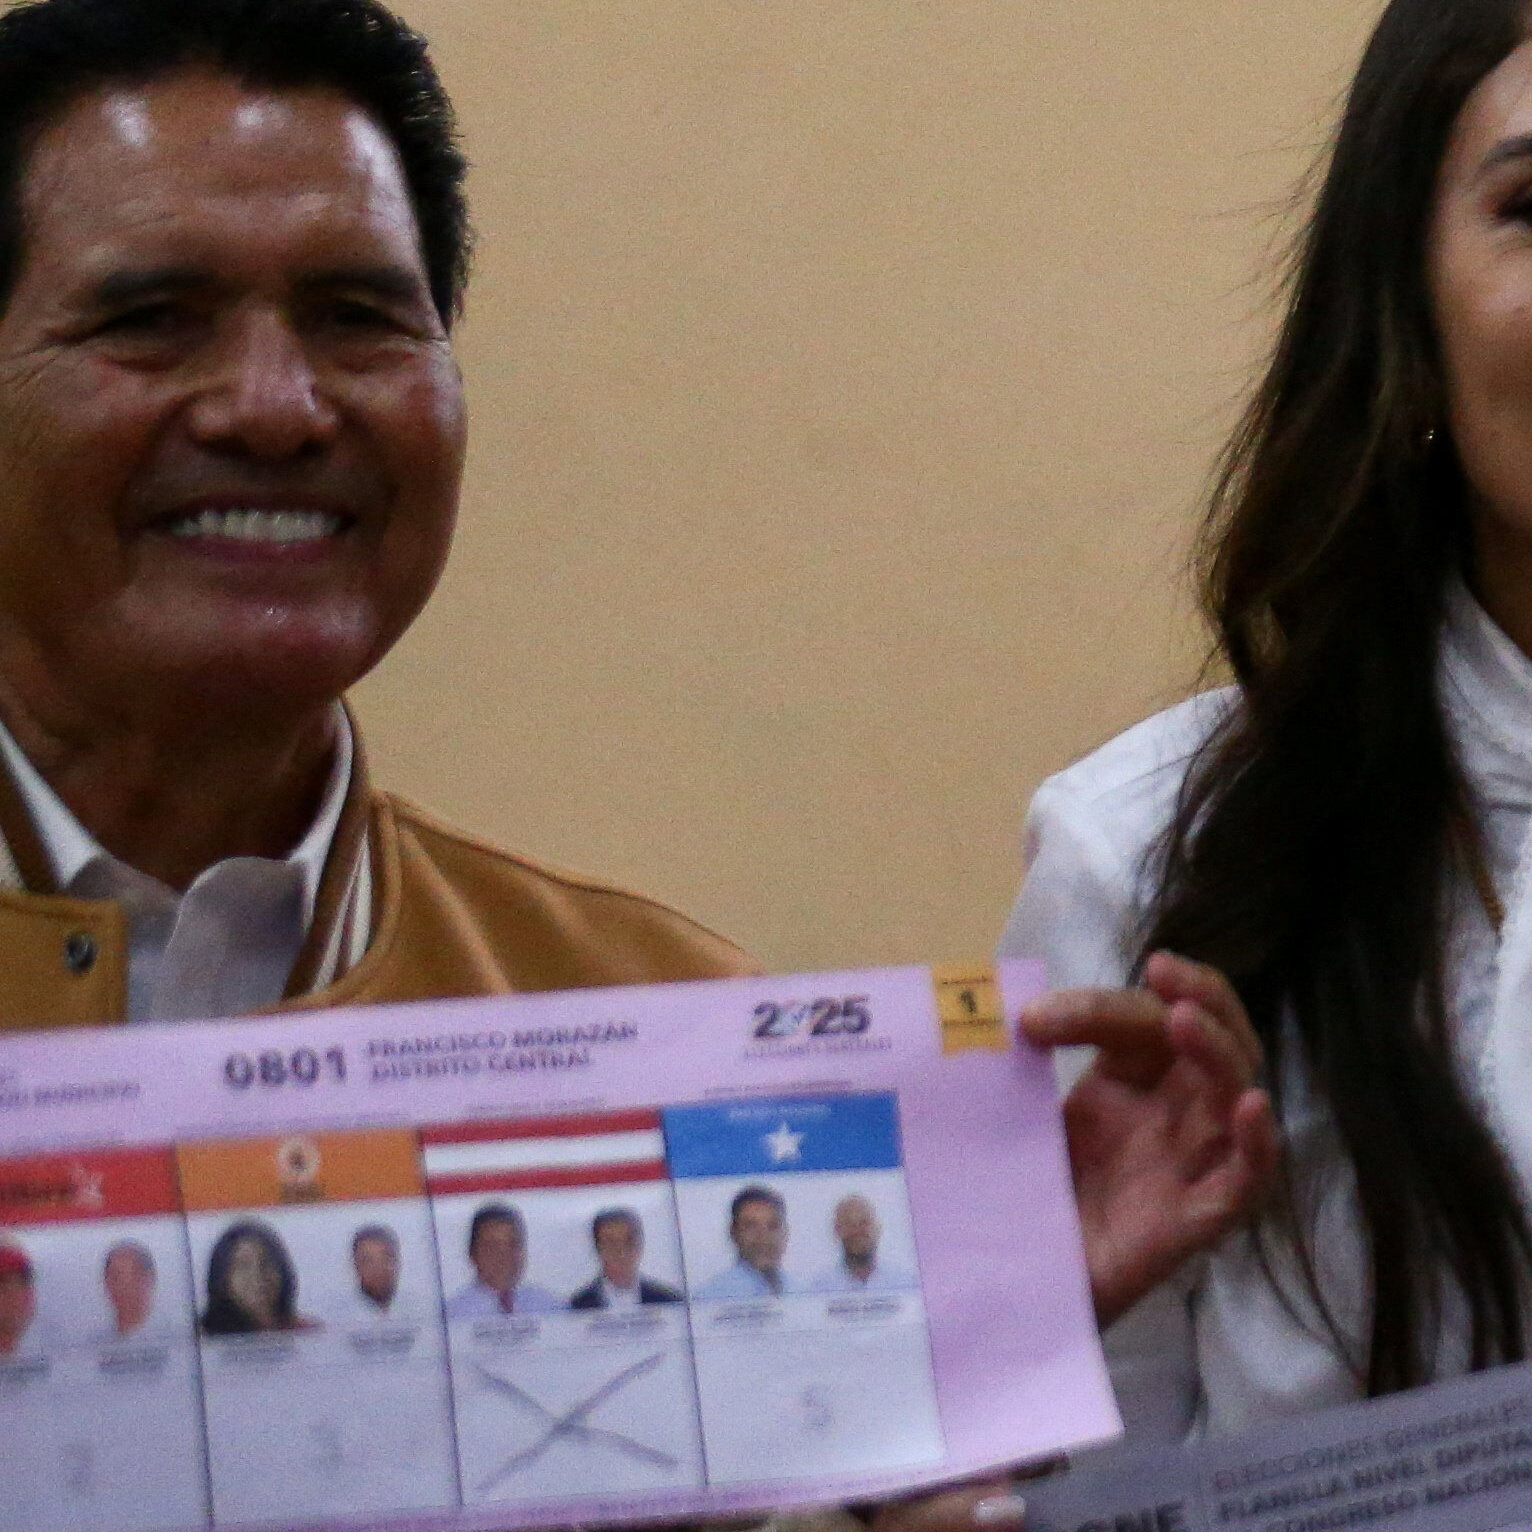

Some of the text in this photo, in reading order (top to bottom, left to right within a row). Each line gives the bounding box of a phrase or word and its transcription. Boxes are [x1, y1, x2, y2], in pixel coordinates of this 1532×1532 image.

[224, 1043, 348, 1090] 0801
[1212, 1438, 1376, 1493] ELECCIONES
[1217, 1475, 1345, 1523] PLANILLA
[1350, 1454, 1429, 1493] NIVEL
